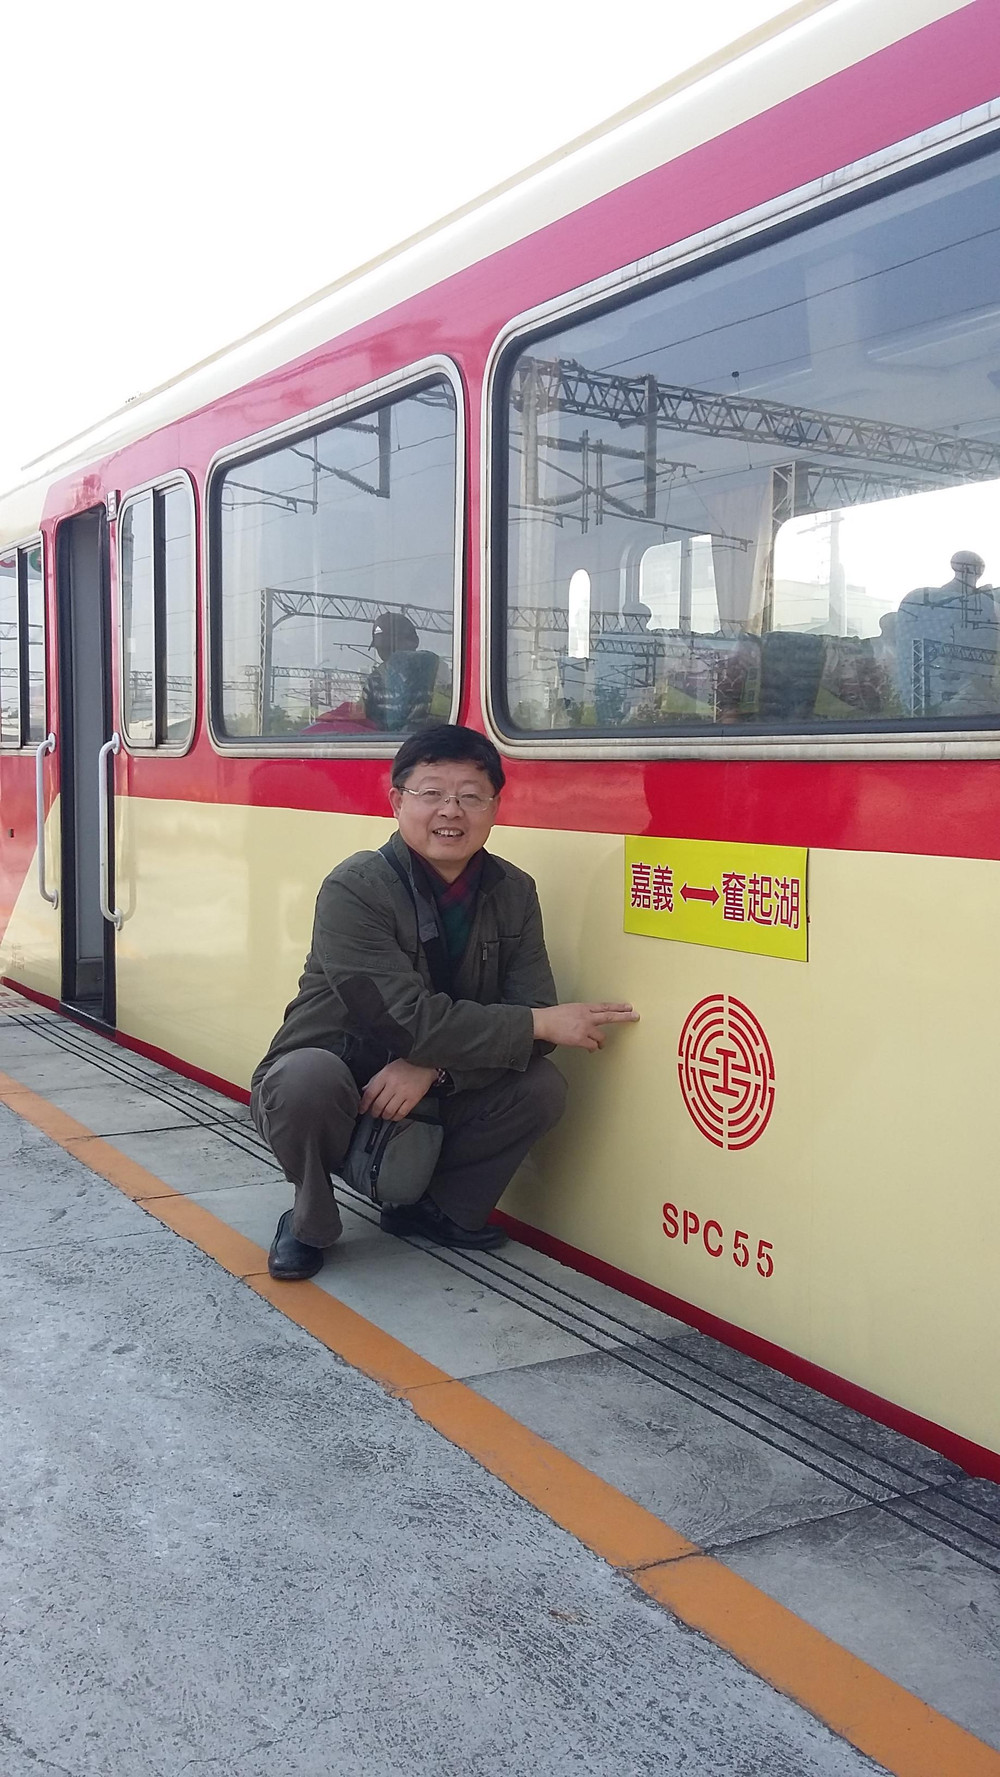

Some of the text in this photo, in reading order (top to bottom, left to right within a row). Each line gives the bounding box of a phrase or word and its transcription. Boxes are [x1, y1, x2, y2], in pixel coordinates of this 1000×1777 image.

[631, 862, 800, 930] 嘉義 奮起湖
[662, 1202, 774, 1278] SPC 55
